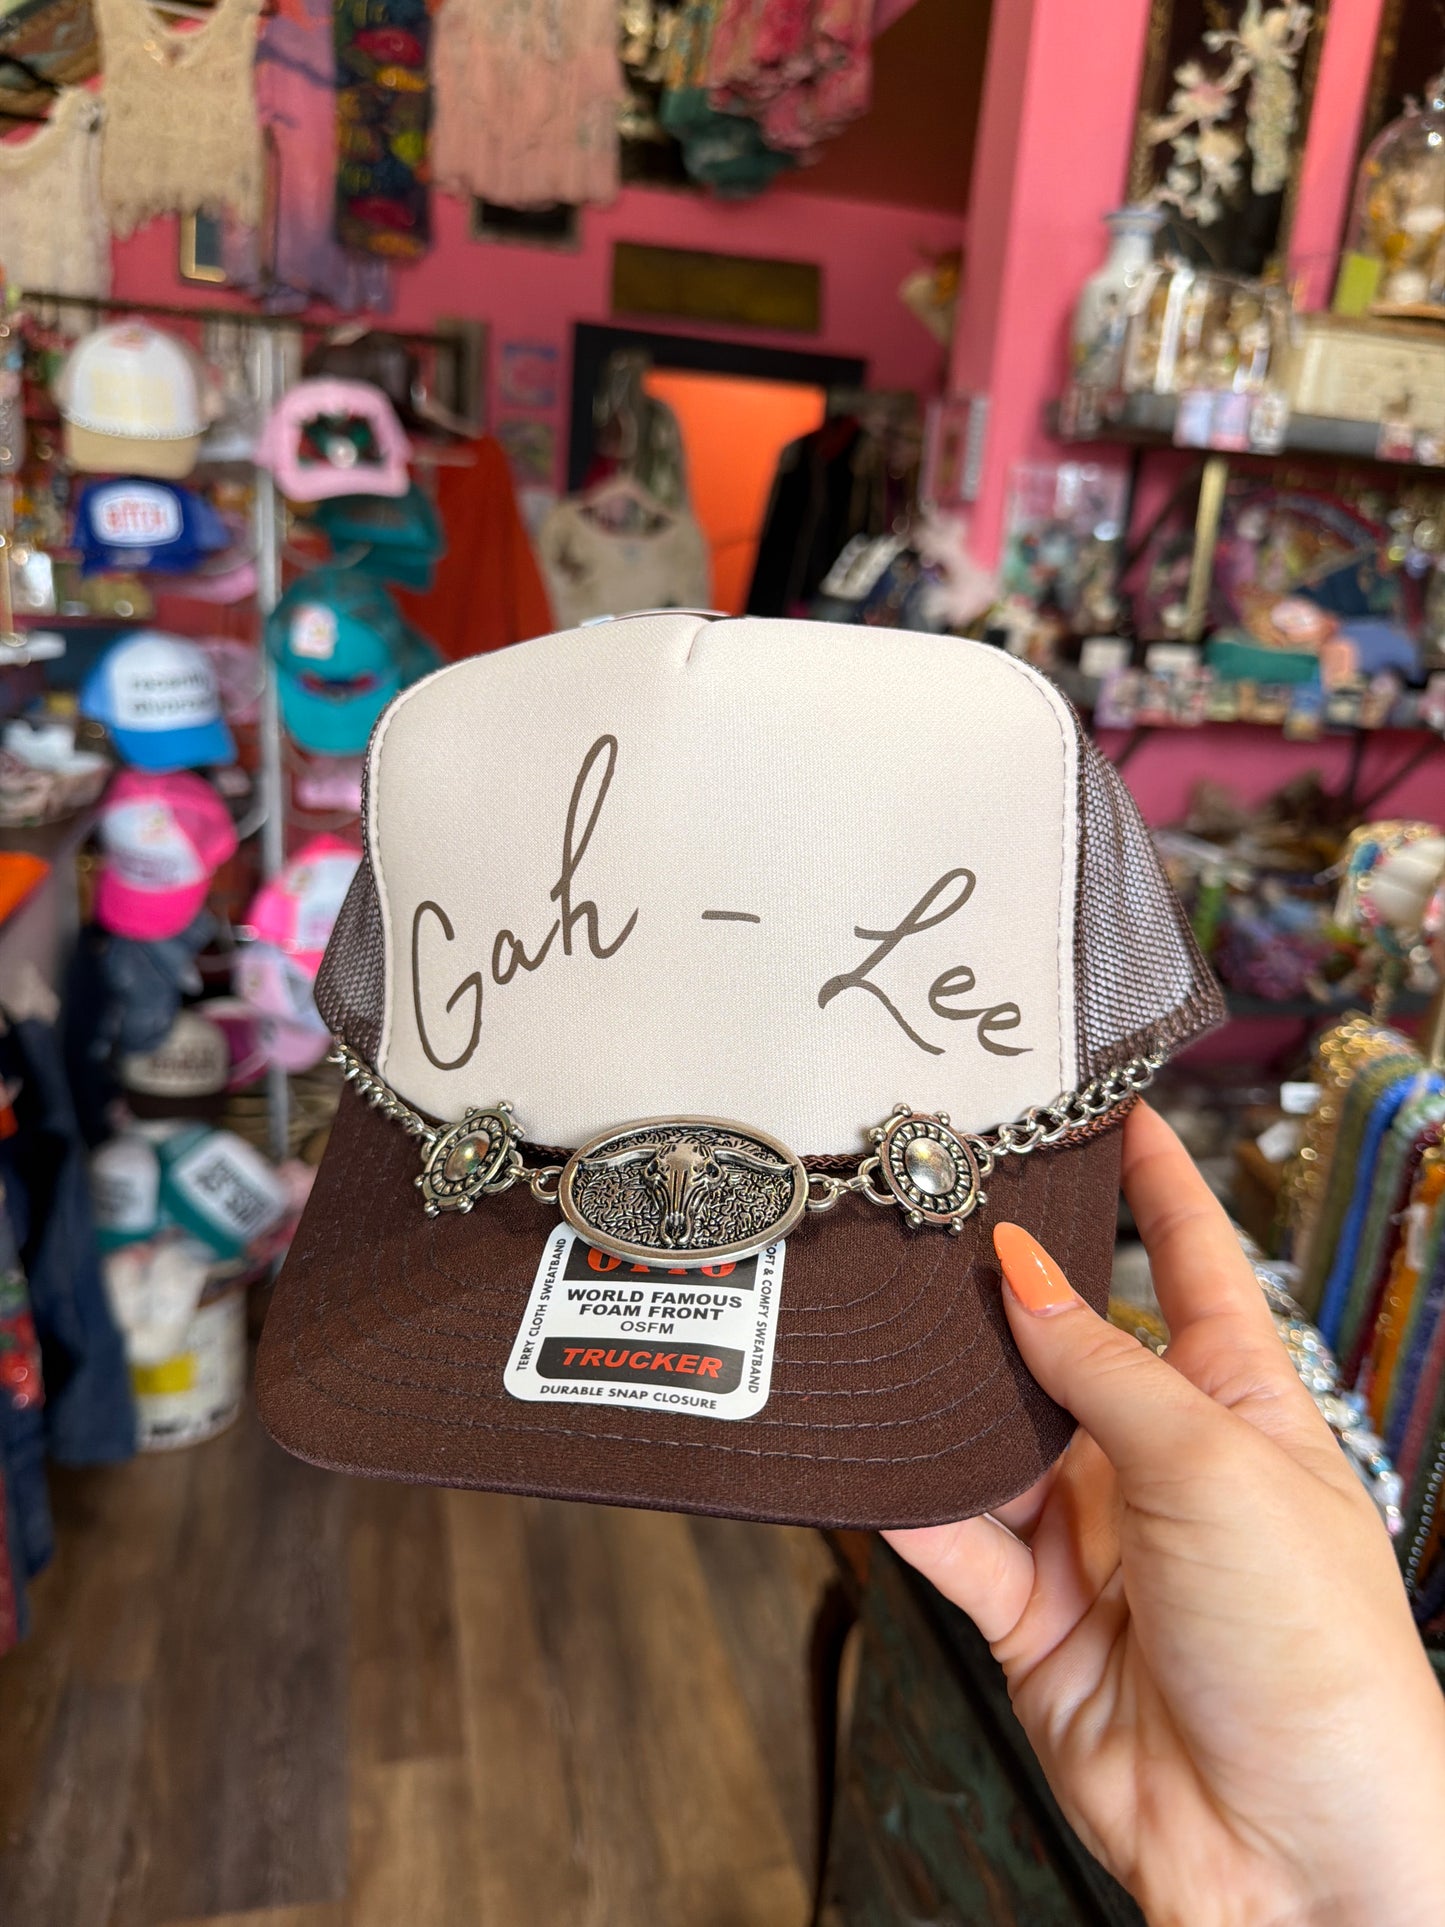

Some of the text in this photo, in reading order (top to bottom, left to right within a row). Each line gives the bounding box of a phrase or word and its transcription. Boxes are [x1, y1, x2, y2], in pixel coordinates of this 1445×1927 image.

[412, 734, 1034, 1071] Gah - Lee
[764, 1243, 778, 1266] OFT
[516, 1238, 567, 1371] TERRY CLOTH SWEATBAND
[567, 1288, 743, 1308] WORLD FAMOUS
[579, 1303, 724, 1321] FOAM FRONT
[758, 1280, 772, 1318] COMFY
[620, 1320, 674, 1335] OSFM
[562, 1347, 723, 1379] TRUCKER
[749, 1321, 768, 1394] SWEATBAND
[540, 1385, 718, 1411] DURABLE SNAP CLOSURE
